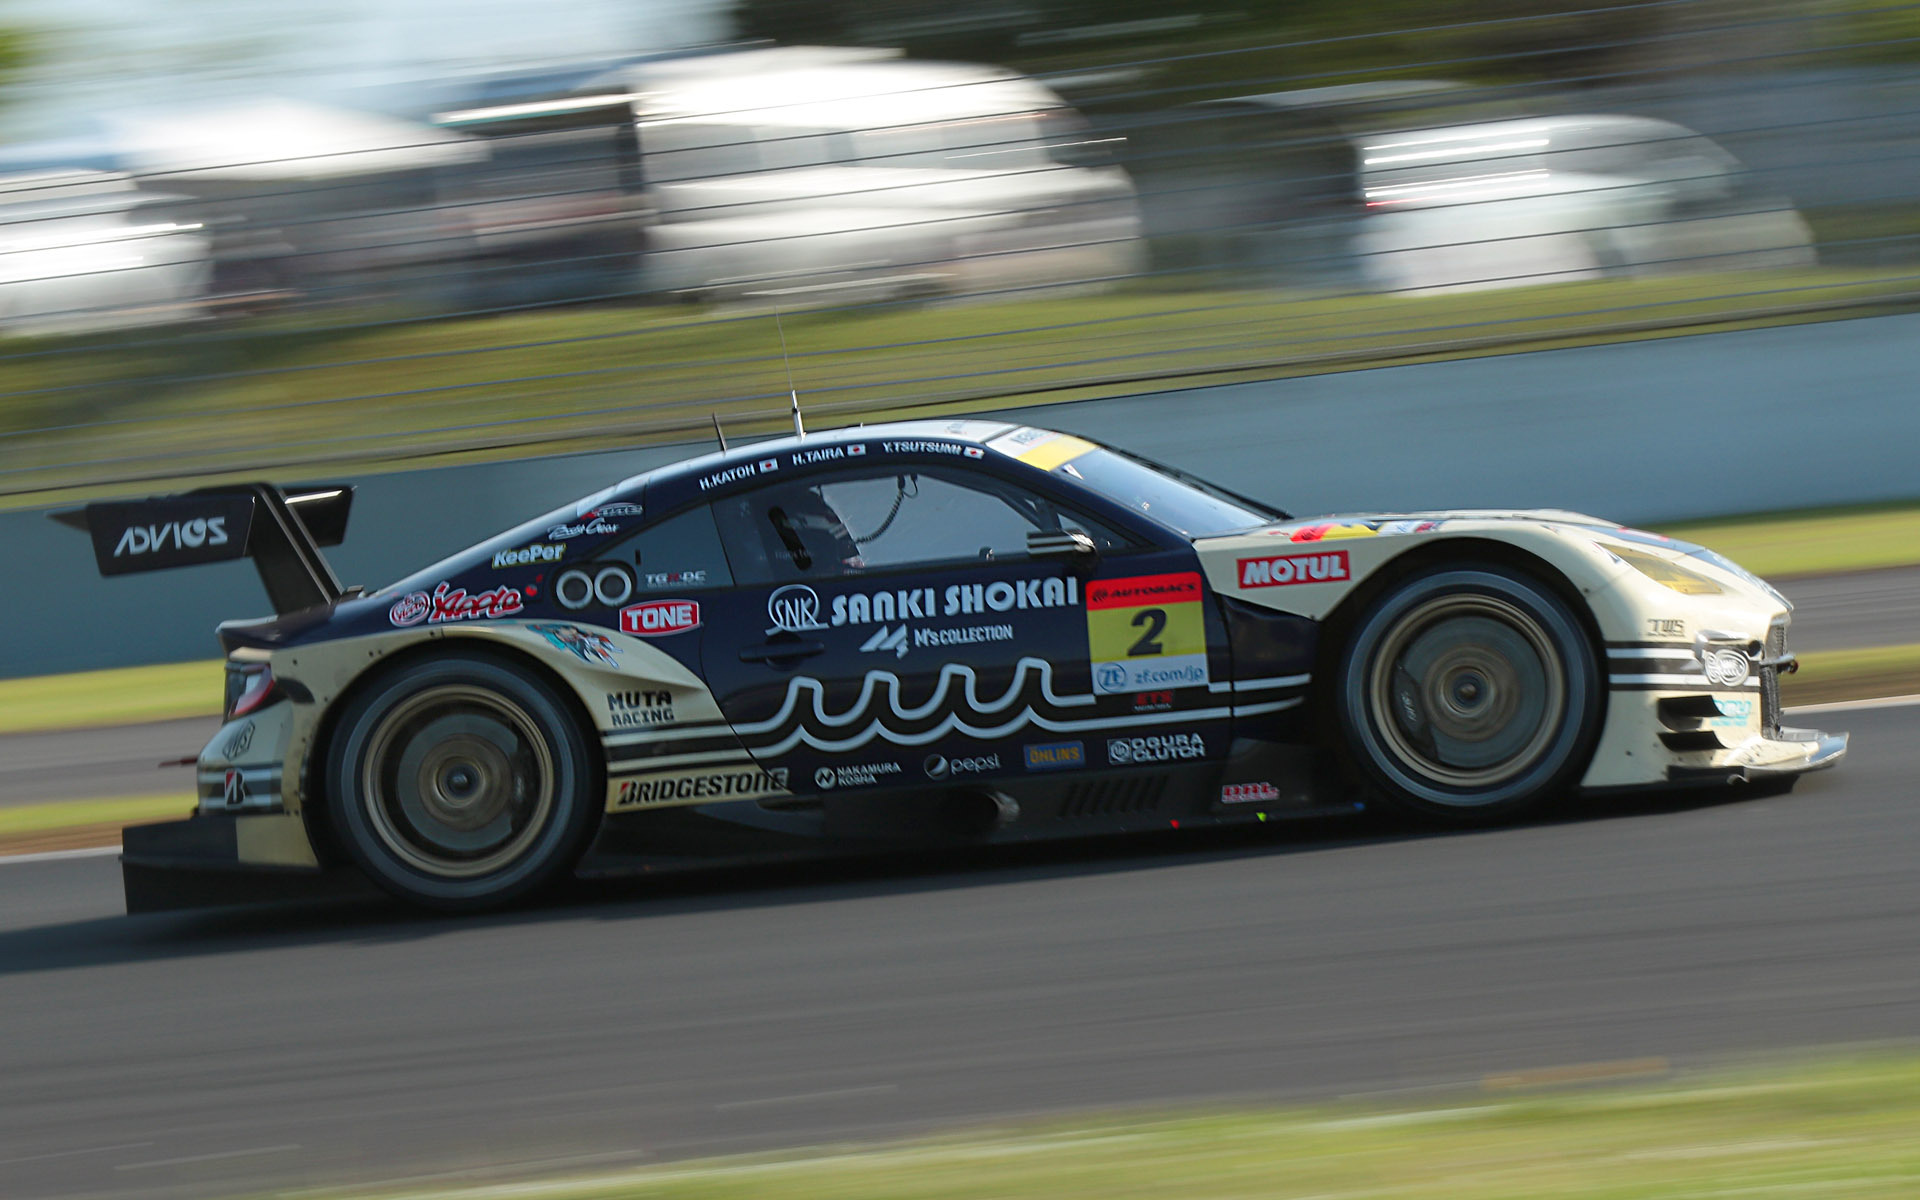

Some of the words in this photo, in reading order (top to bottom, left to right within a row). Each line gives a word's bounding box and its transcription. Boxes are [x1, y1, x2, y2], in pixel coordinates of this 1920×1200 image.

[792, 446, 844, 466] H.TAIRA
[882, 441, 962, 456] Y.TSUTSUMI
[699, 464, 756, 491] H.KATOH
[114, 516, 229, 557] ADVICS
[492, 543, 566, 569] KeePer
[1242, 554, 1346, 585] MOTUL
[1111, 583, 1196, 597] AUTOBACS
[831, 587, 937, 627] SANKI
[944, 577, 1079, 617] SHOKAI
[626, 604, 693, 630] TONE
[1648, 618, 1685, 633] TWS
[940, 624, 1014, 646] COLLECTION
[1127, 607, 1168, 657] 2
[1134, 665, 1204, 684] zf.com/jp
[607, 689, 672, 711] MUTA
[611, 708, 675, 726] RACING
[1131, 733, 1205, 749] OGURA
[951, 752, 1001, 775] pepsi
[1030, 745, 1081, 764] ÖHLINS
[1132, 744, 1206, 762] CLUTCH
[836, 762, 902, 776] NAKAMURA
[618, 771, 787, 806] BRIDGESTONE
